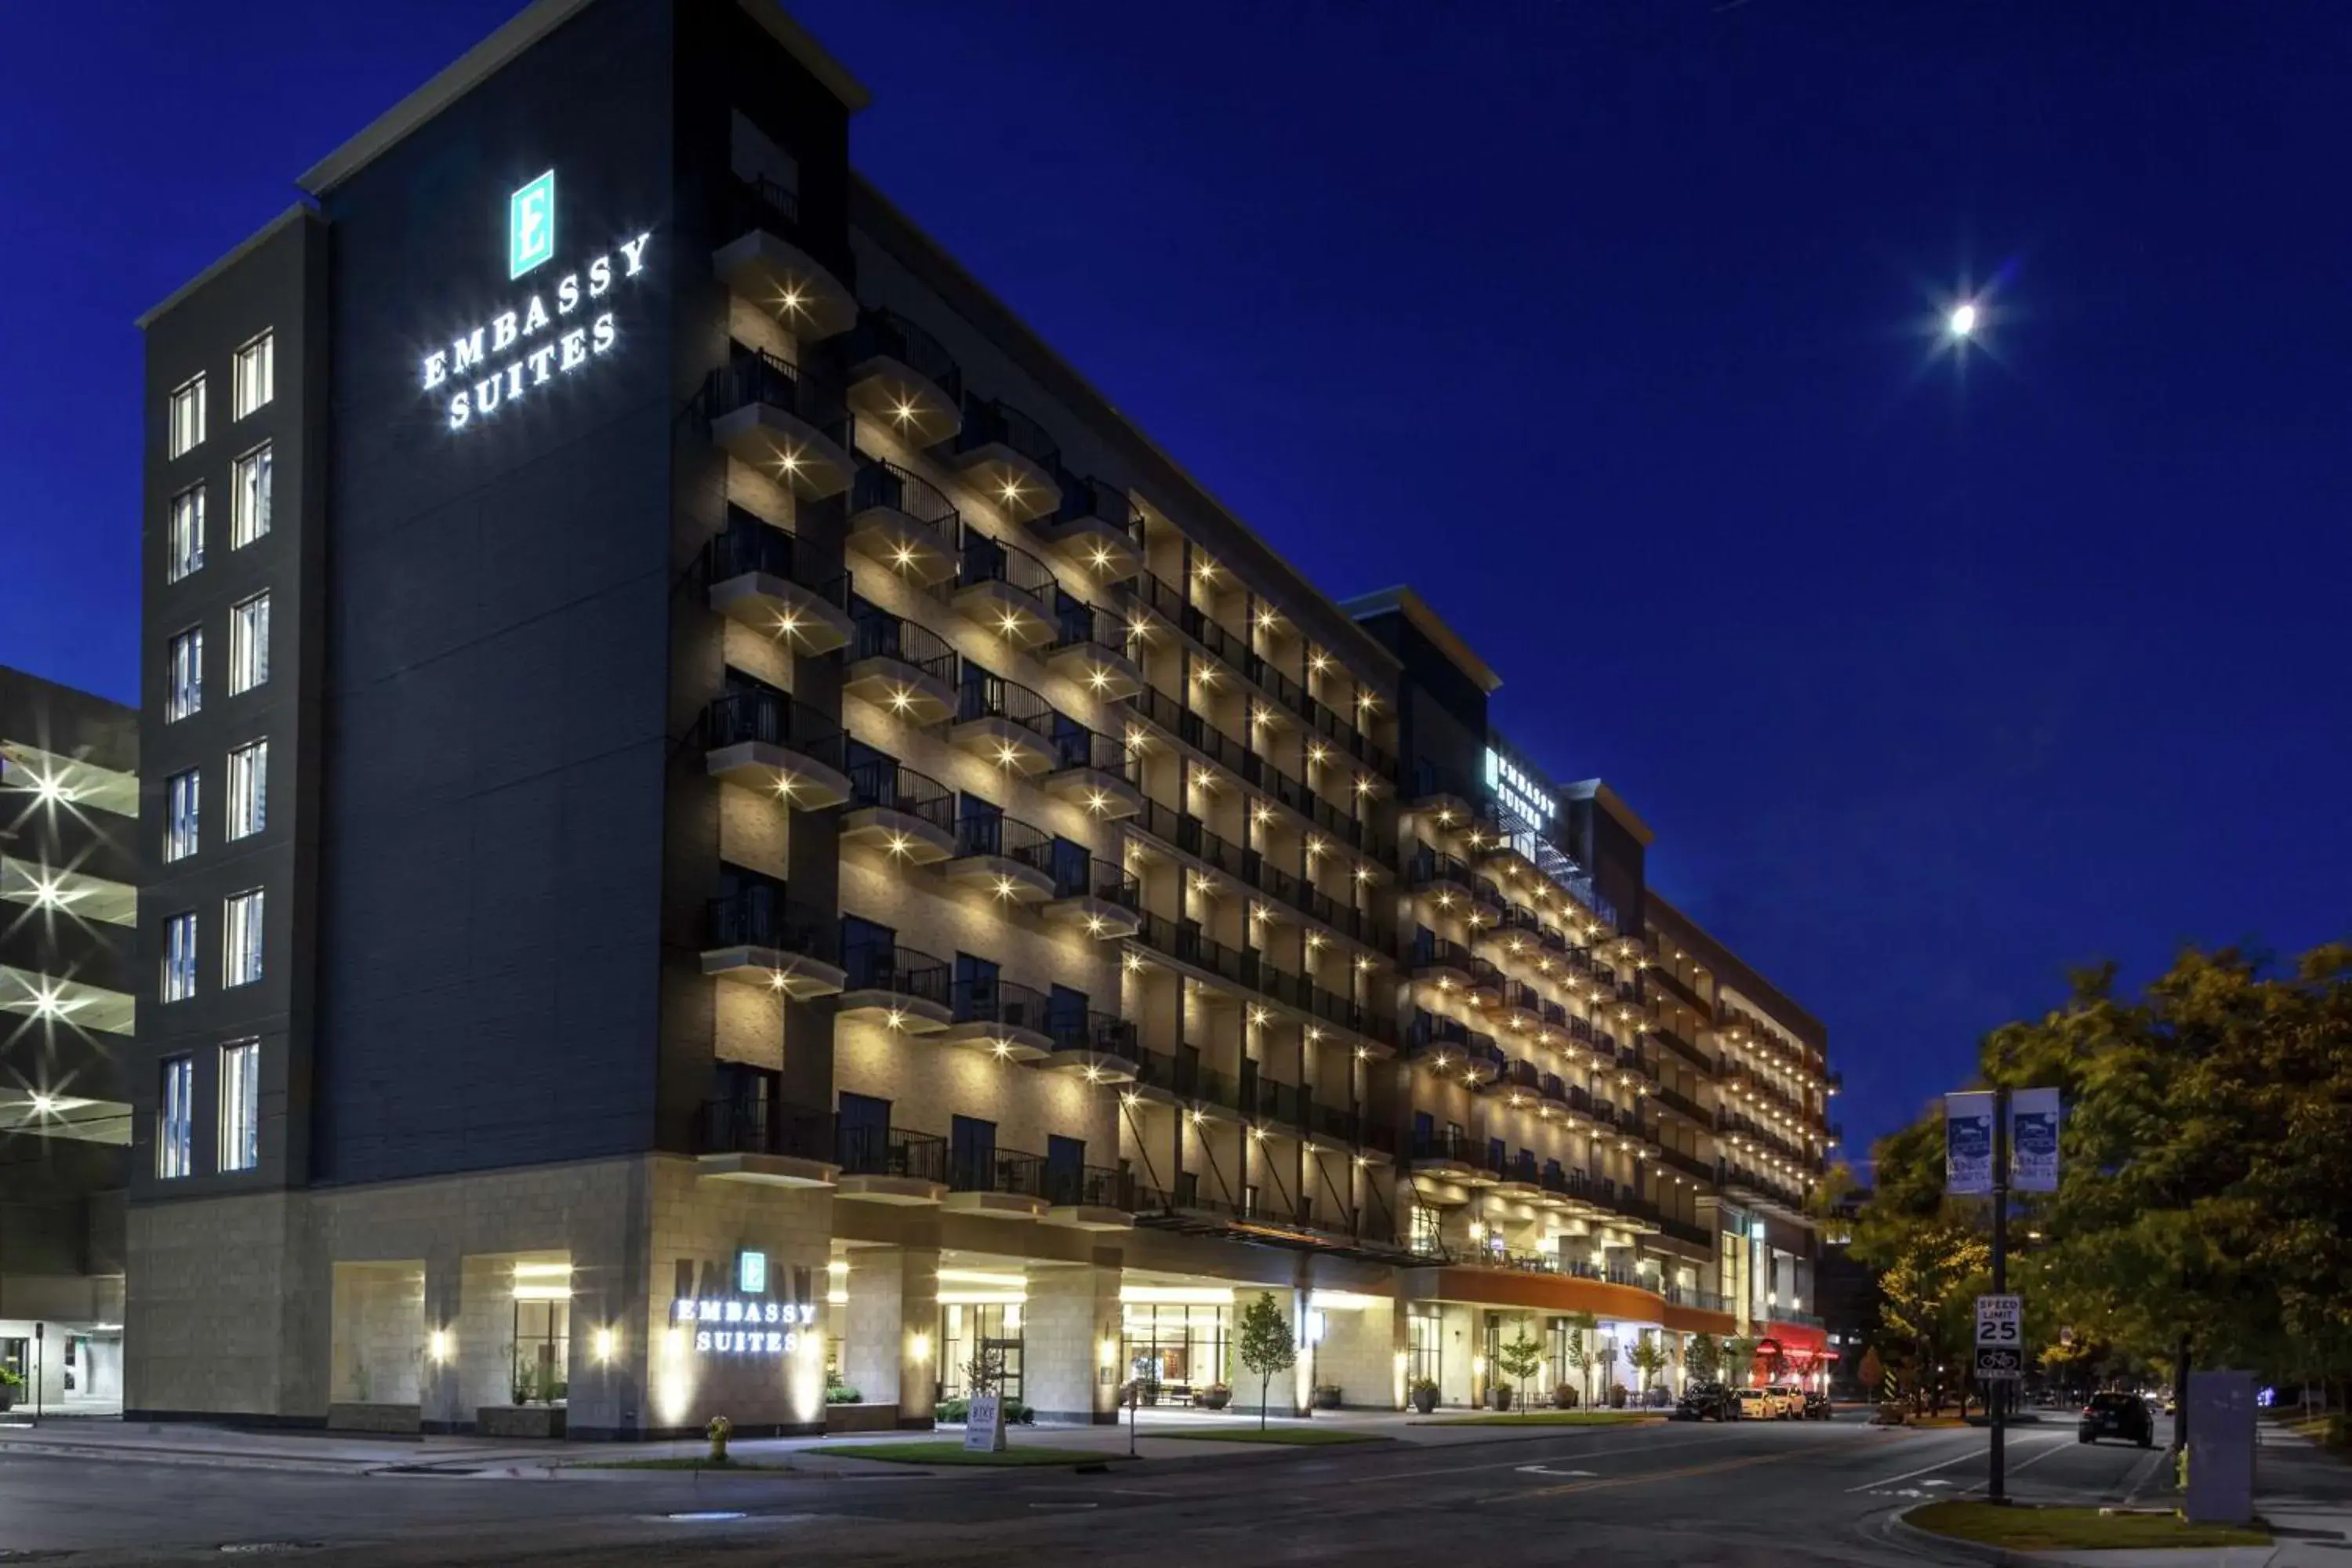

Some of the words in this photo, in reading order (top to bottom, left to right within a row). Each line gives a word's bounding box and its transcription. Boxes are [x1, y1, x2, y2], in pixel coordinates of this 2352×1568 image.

[518, 187, 546, 262] E
[424, 232, 650, 390] EMBASSY
[451, 313, 615, 429] SUITES
[1498, 756, 1556, 818] EMBASSY
[677, 1299, 816, 1324] EMBASSY
[1980, 1300, 2018, 1309] SPEED
[1983, 1310, 2013, 1319] LIMIT
[695, 1330, 797, 1352] SUITES
[1980, 1321, 2016, 1340] 25
